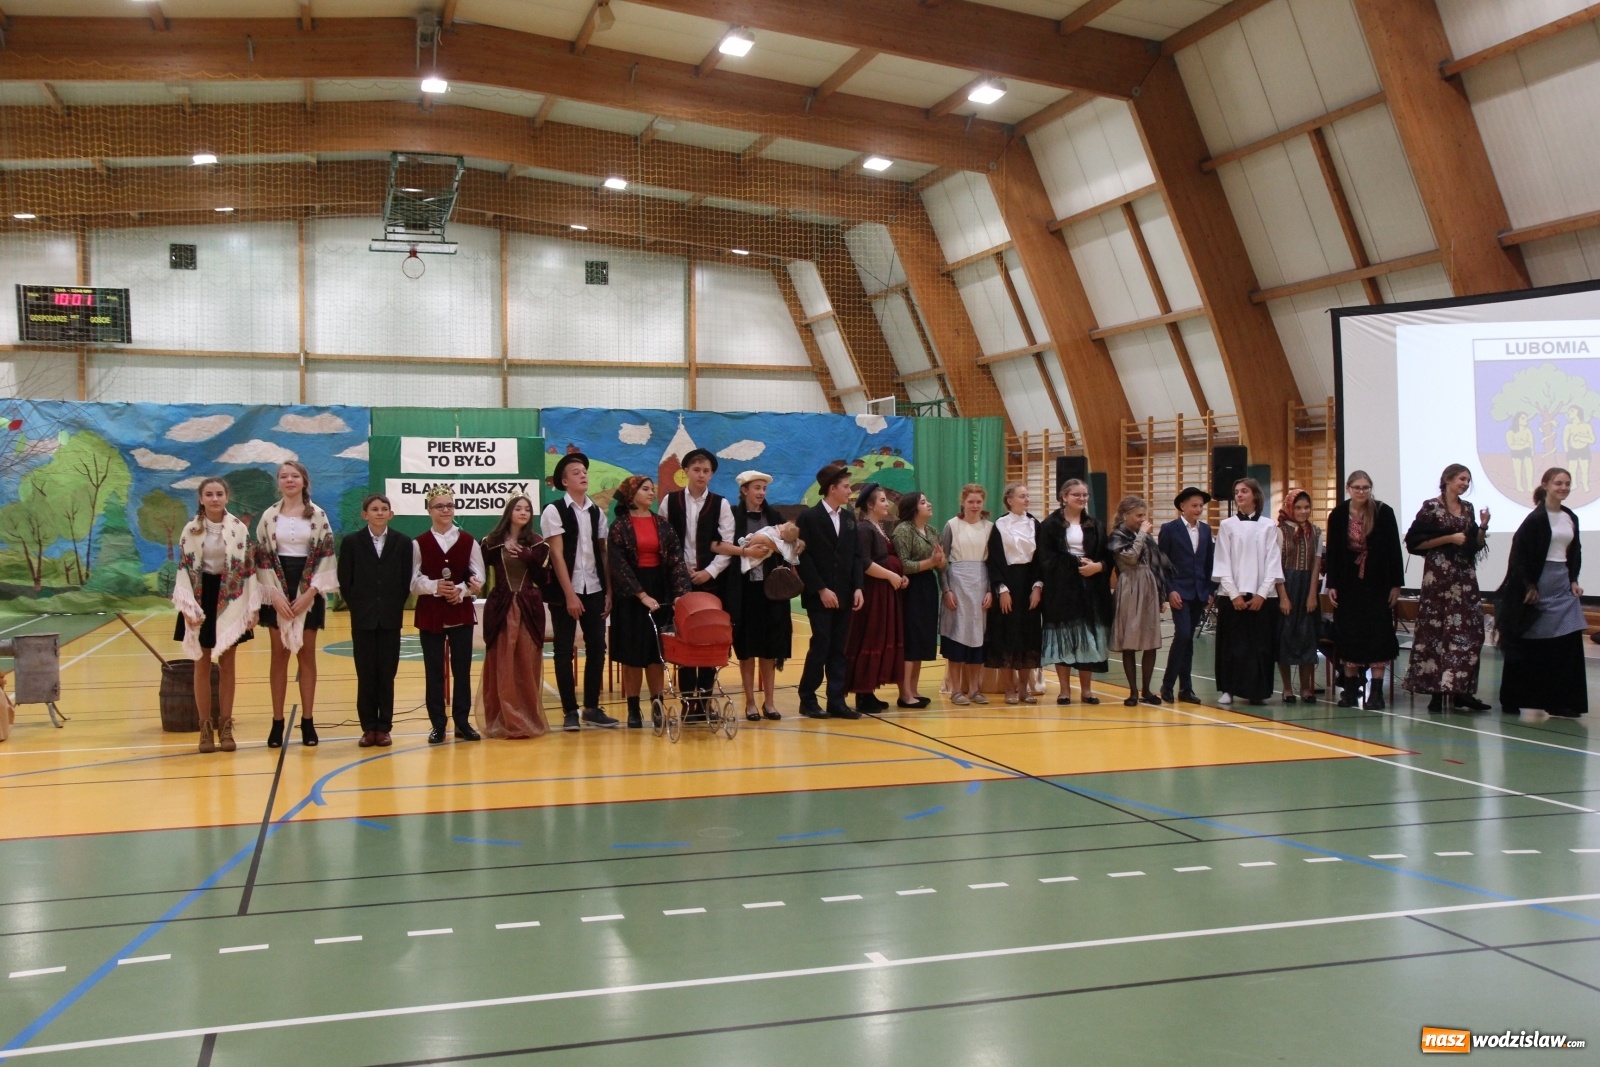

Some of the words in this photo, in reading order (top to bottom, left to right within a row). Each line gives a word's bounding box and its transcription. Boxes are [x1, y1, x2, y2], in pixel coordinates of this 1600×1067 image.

[1505, 341, 1590, 355] LUBOMIA
[427, 441, 496, 453] PIERWEJ
[428, 455, 450, 467] TO
[454, 455, 496, 467] BYŁO
[460, 482, 529, 494] INAKSZY
